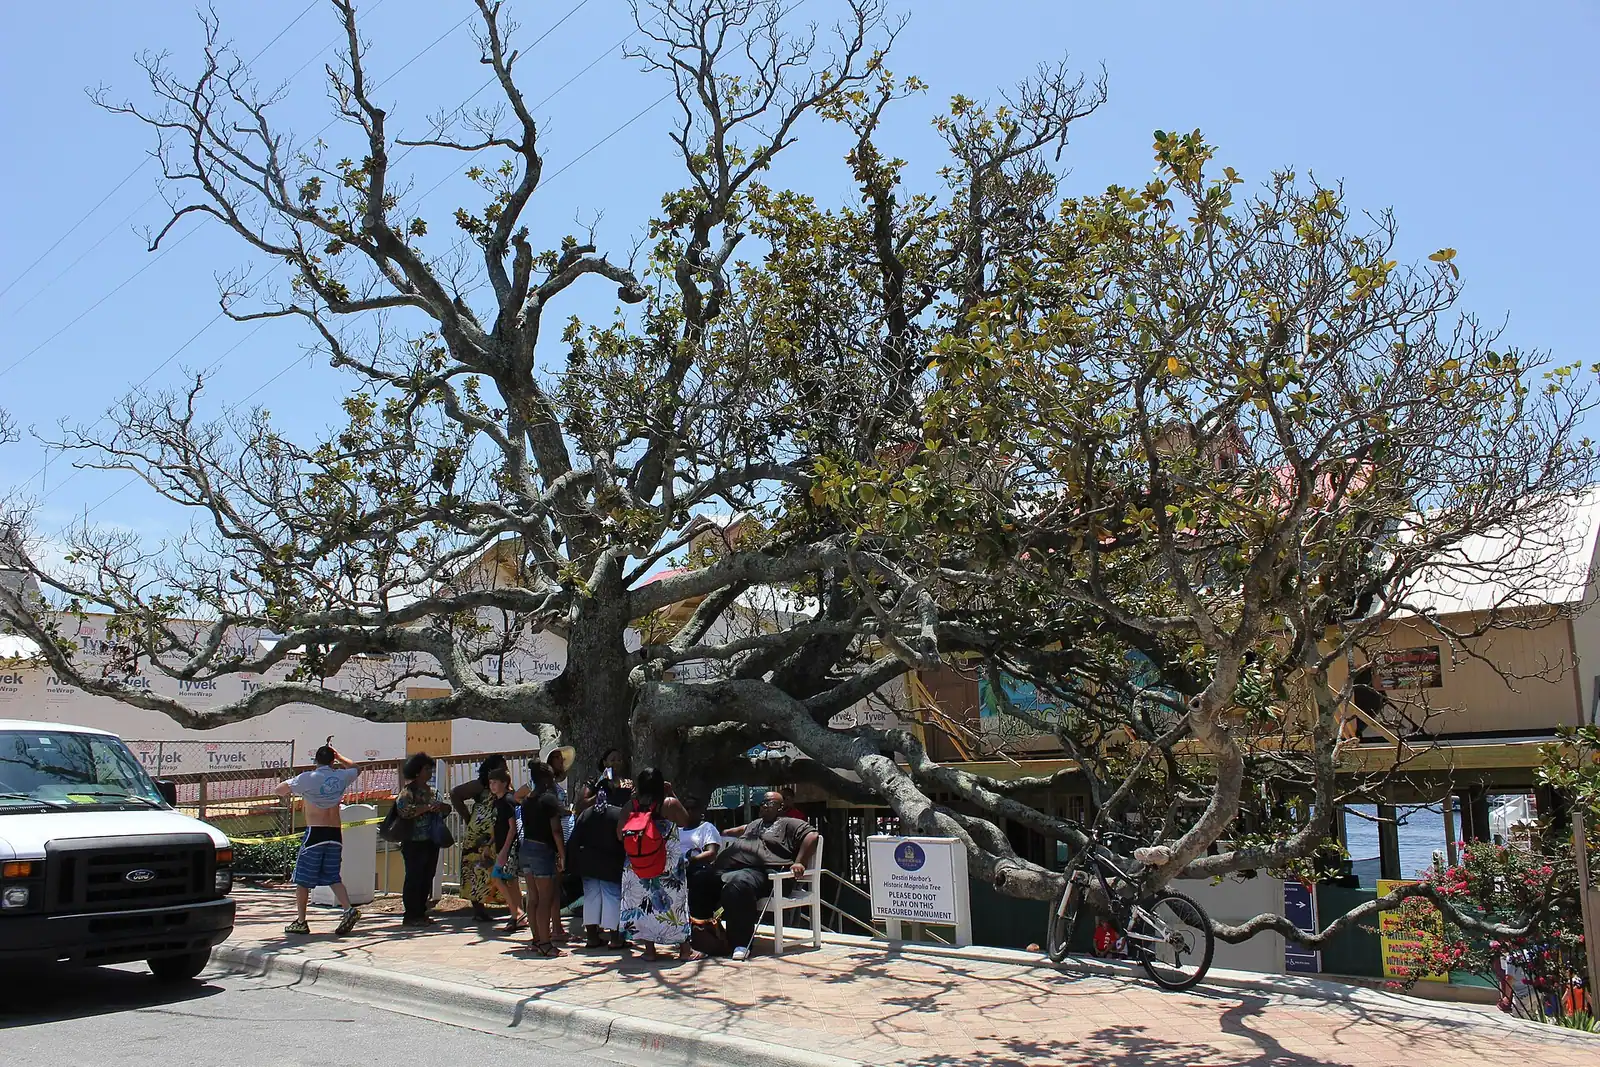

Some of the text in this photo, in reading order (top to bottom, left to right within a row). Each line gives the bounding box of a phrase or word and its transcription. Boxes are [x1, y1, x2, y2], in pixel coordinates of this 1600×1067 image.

[533, 660, 560, 671] Tyvek
[179, 680, 216, 691] Tyvek
[864, 712, 886, 722] Tyvek
[140, 752, 181, 765] Tyvek
[207, 752, 246, 764] Tyvek
[889, 891, 911, 899] PLEASE
[877, 907, 952, 919] TREASURED MONUMENT
